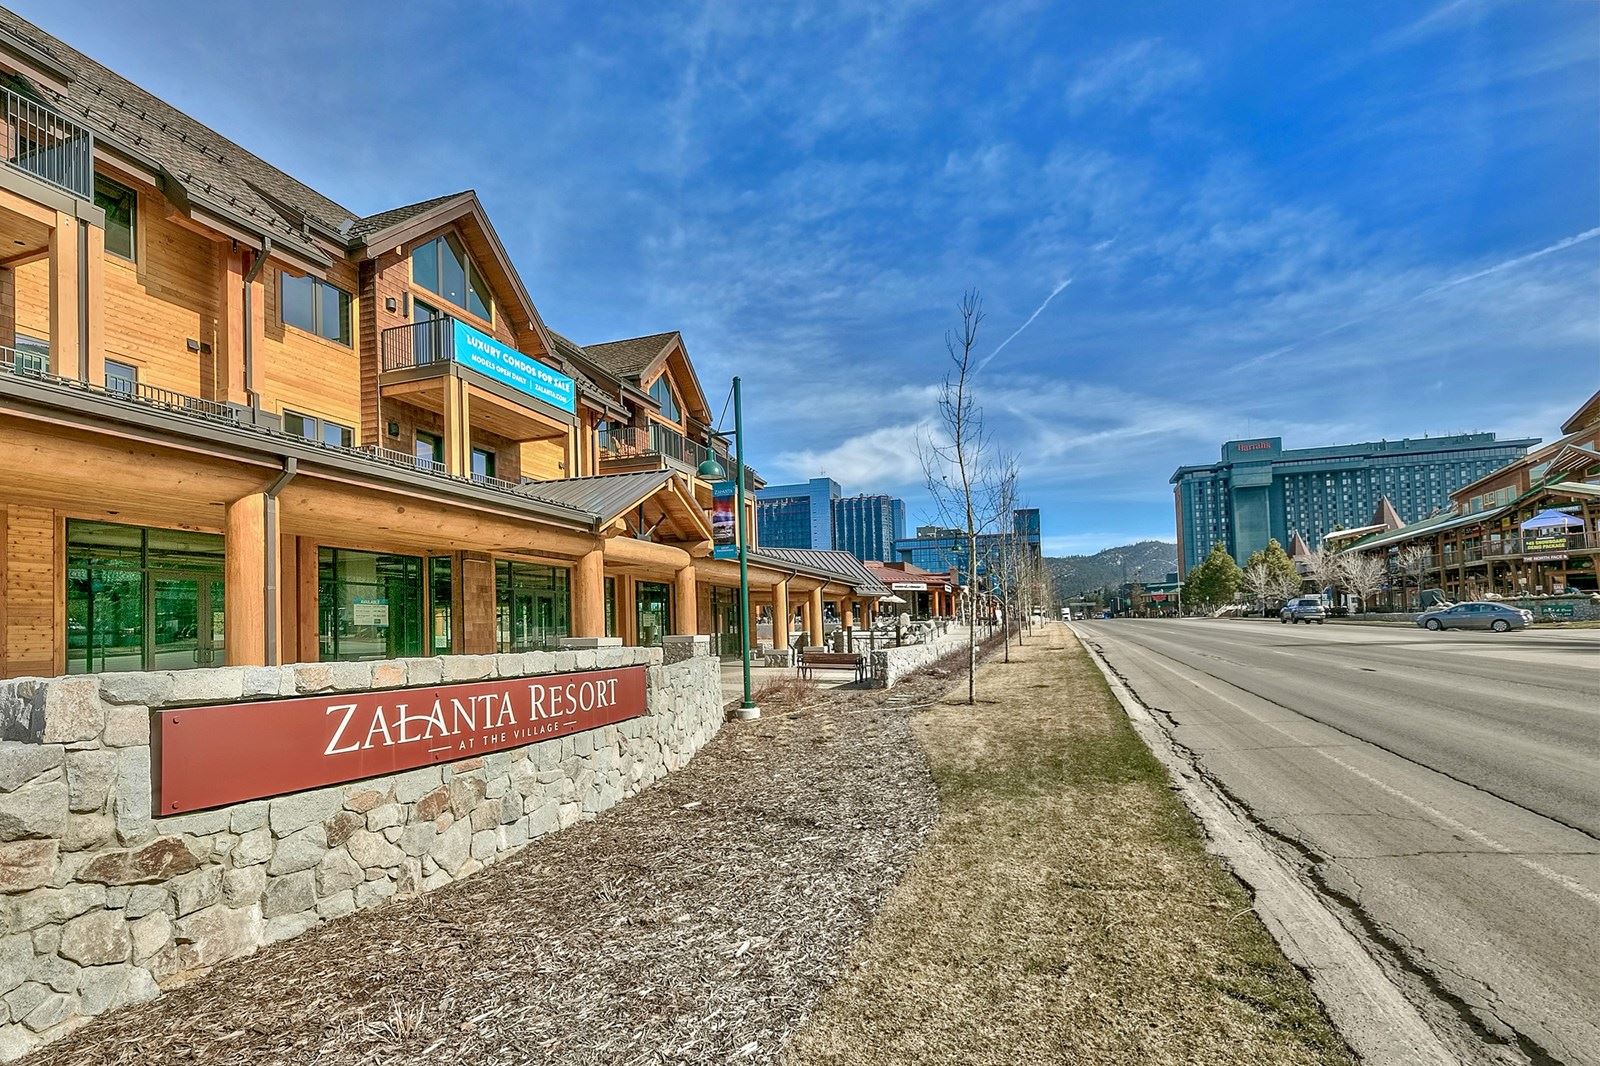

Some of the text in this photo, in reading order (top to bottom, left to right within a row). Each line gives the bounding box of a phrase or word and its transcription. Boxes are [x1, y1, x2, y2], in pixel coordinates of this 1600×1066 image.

[467, 334, 570, 393] LUXURY CONDOS FOR SALE
[471, 354, 527, 384] MODELS OPEN DAILY
[534, 383, 567, 402] ZALANTA.COM
[324, 678, 619, 756] ZALANTA RESORT
[458, 721, 559, 751] AT THE VILLAGE
